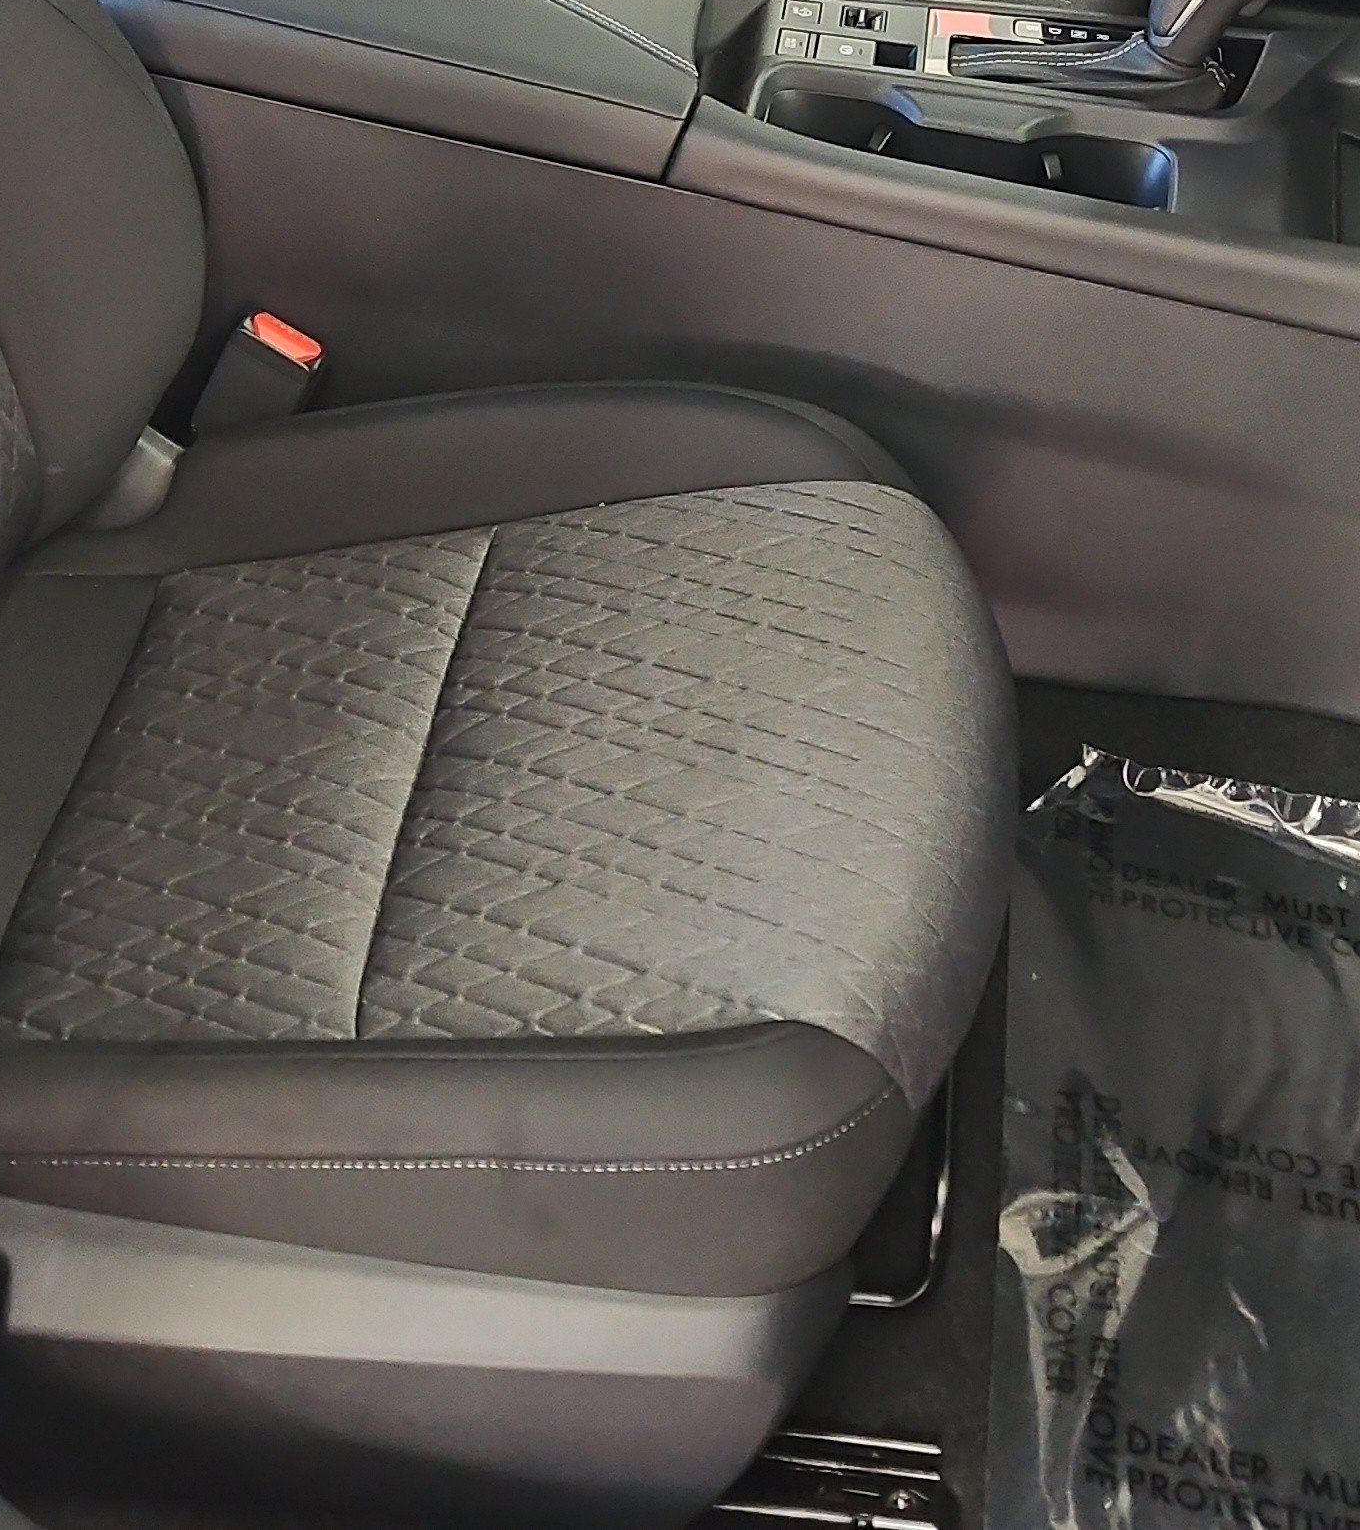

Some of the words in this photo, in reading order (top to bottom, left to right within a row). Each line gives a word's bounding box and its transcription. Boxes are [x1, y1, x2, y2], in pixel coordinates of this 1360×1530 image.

[1121, 885, 1314, 950] PROTECTIVE
[1123, 860, 1238, 903] DEALER
[1265, 890, 1352, 929] MUST
[1130, 1137, 1275, 1203] REMOVE
[1207, 1130, 1321, 1180] COVER
[1045, 1283, 1079, 1396] COVER
[1125, 1423, 1273, 1484] DEALER
